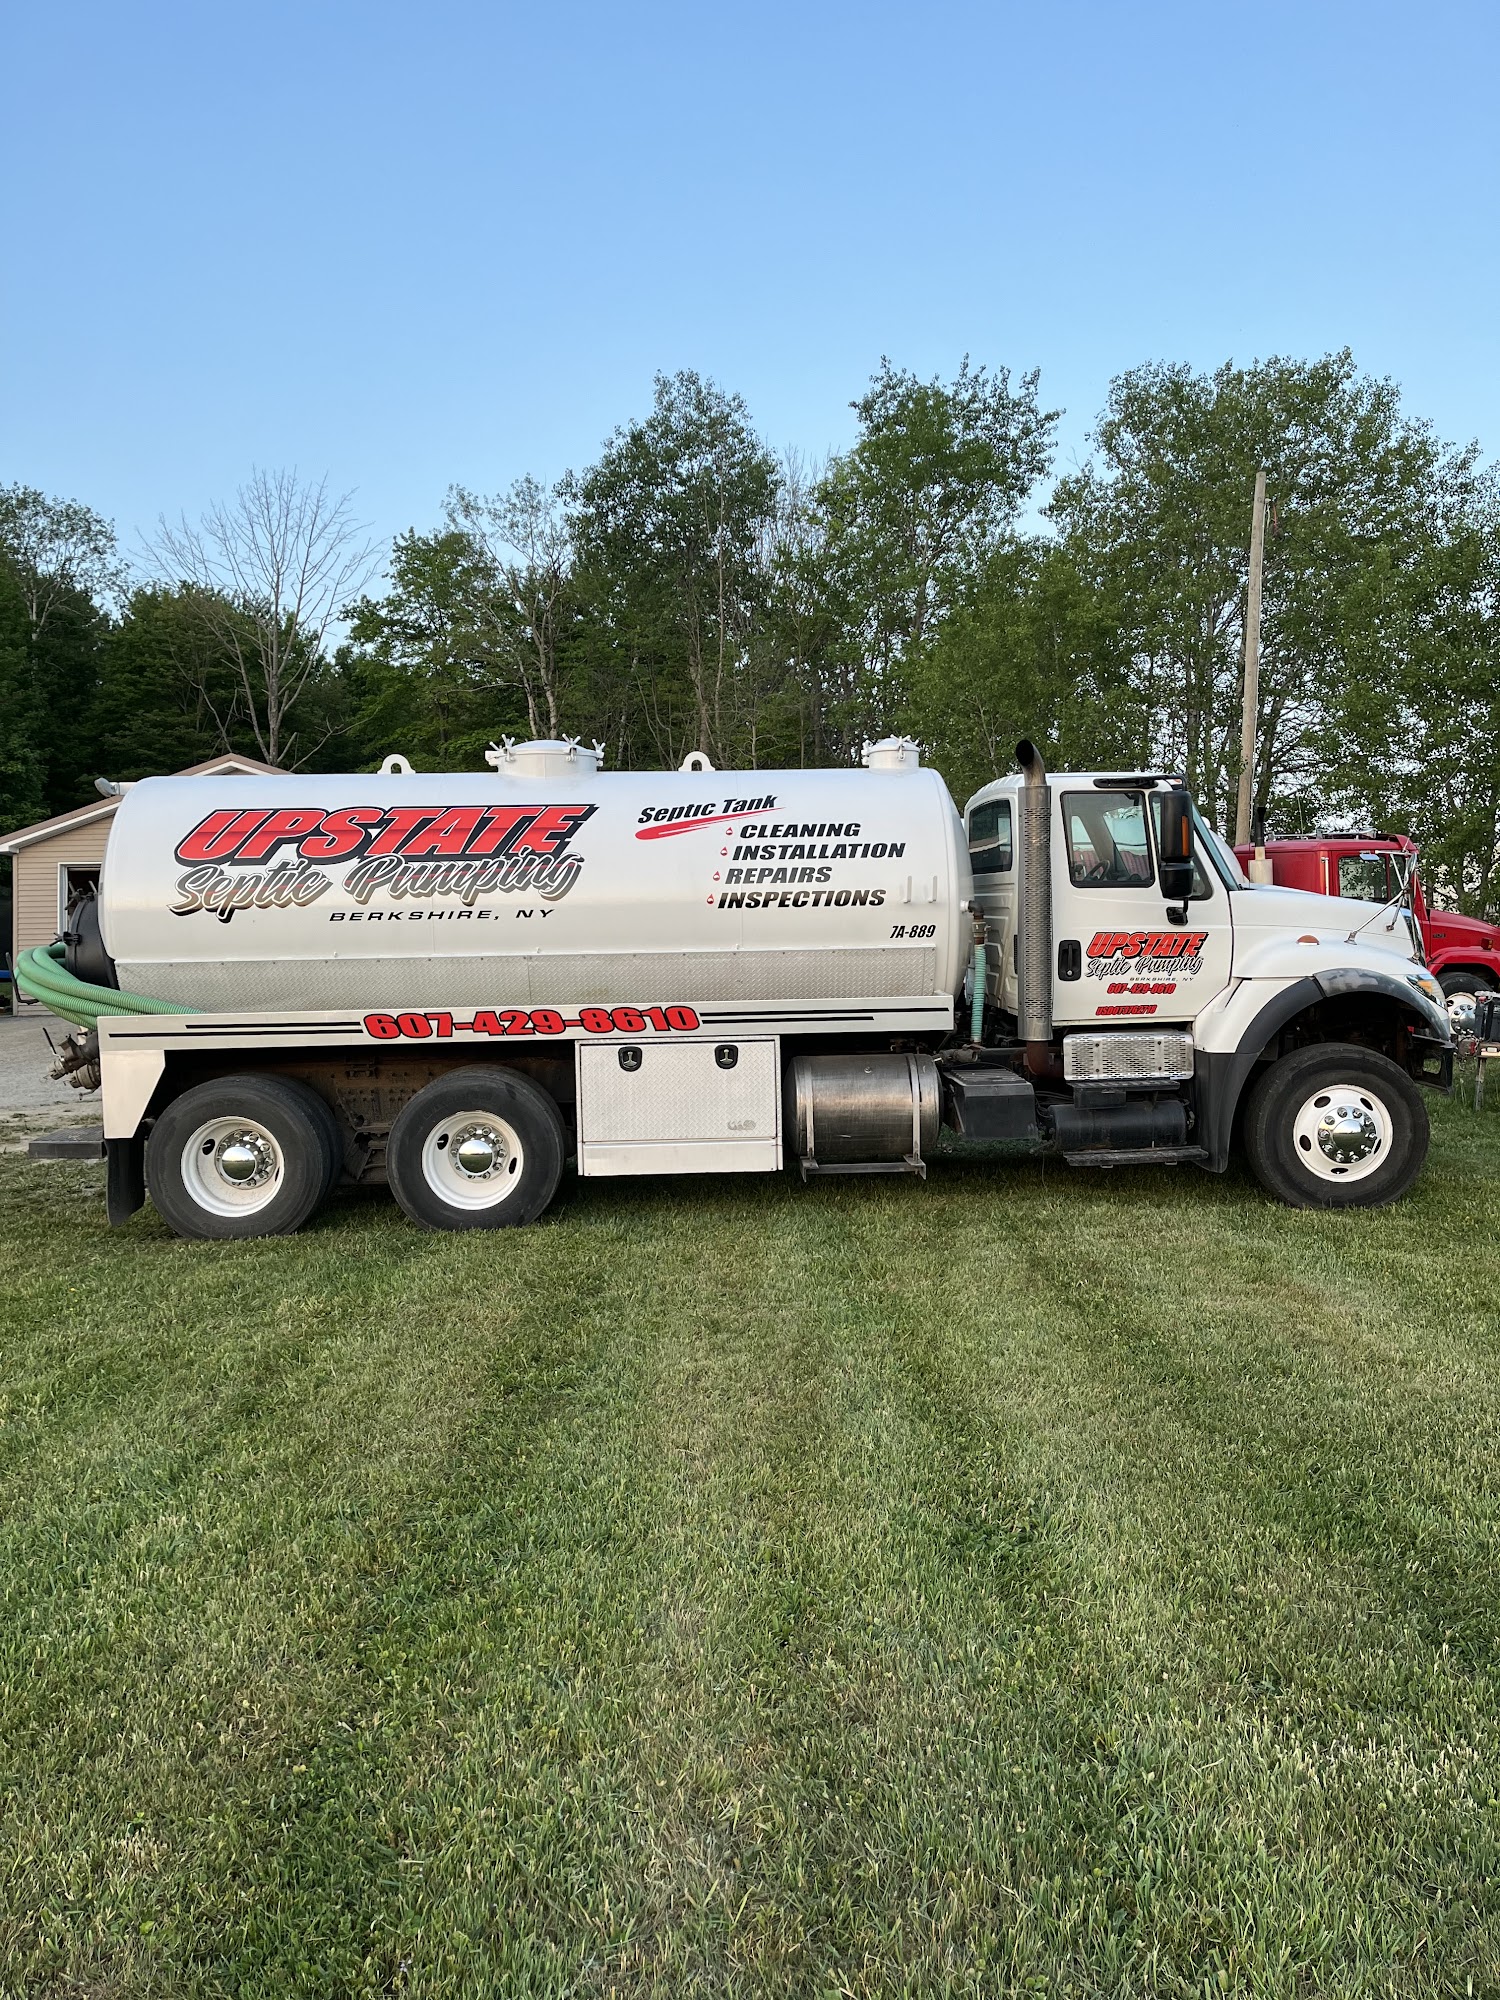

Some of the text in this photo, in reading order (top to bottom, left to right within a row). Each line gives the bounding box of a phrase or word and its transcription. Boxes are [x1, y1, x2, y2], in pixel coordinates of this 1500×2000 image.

[637, 795, 778, 823] Septic Tank
[174, 804, 599, 867] UPSTATE
[740, 823, 861, 838] CLEANING
[732, 843, 906, 861] INSTALLATION
[166, 845, 585, 923] Septic Pumping
[725, 867, 832, 884] REPAIRS
[717, 889, 886, 909] INSPECTIONS
[329, 909, 555, 921] BERKSHIRE, NY
[890, 925, 936, 939] 7A-889
[1086, 932, 1209, 959] UPSTATE
[1085, 953, 1204, 980] Septic Pumping
[1107, 983, 1176, 994] 607-429-8610
[363, 1005, 700, 1039] 607-429-8610
